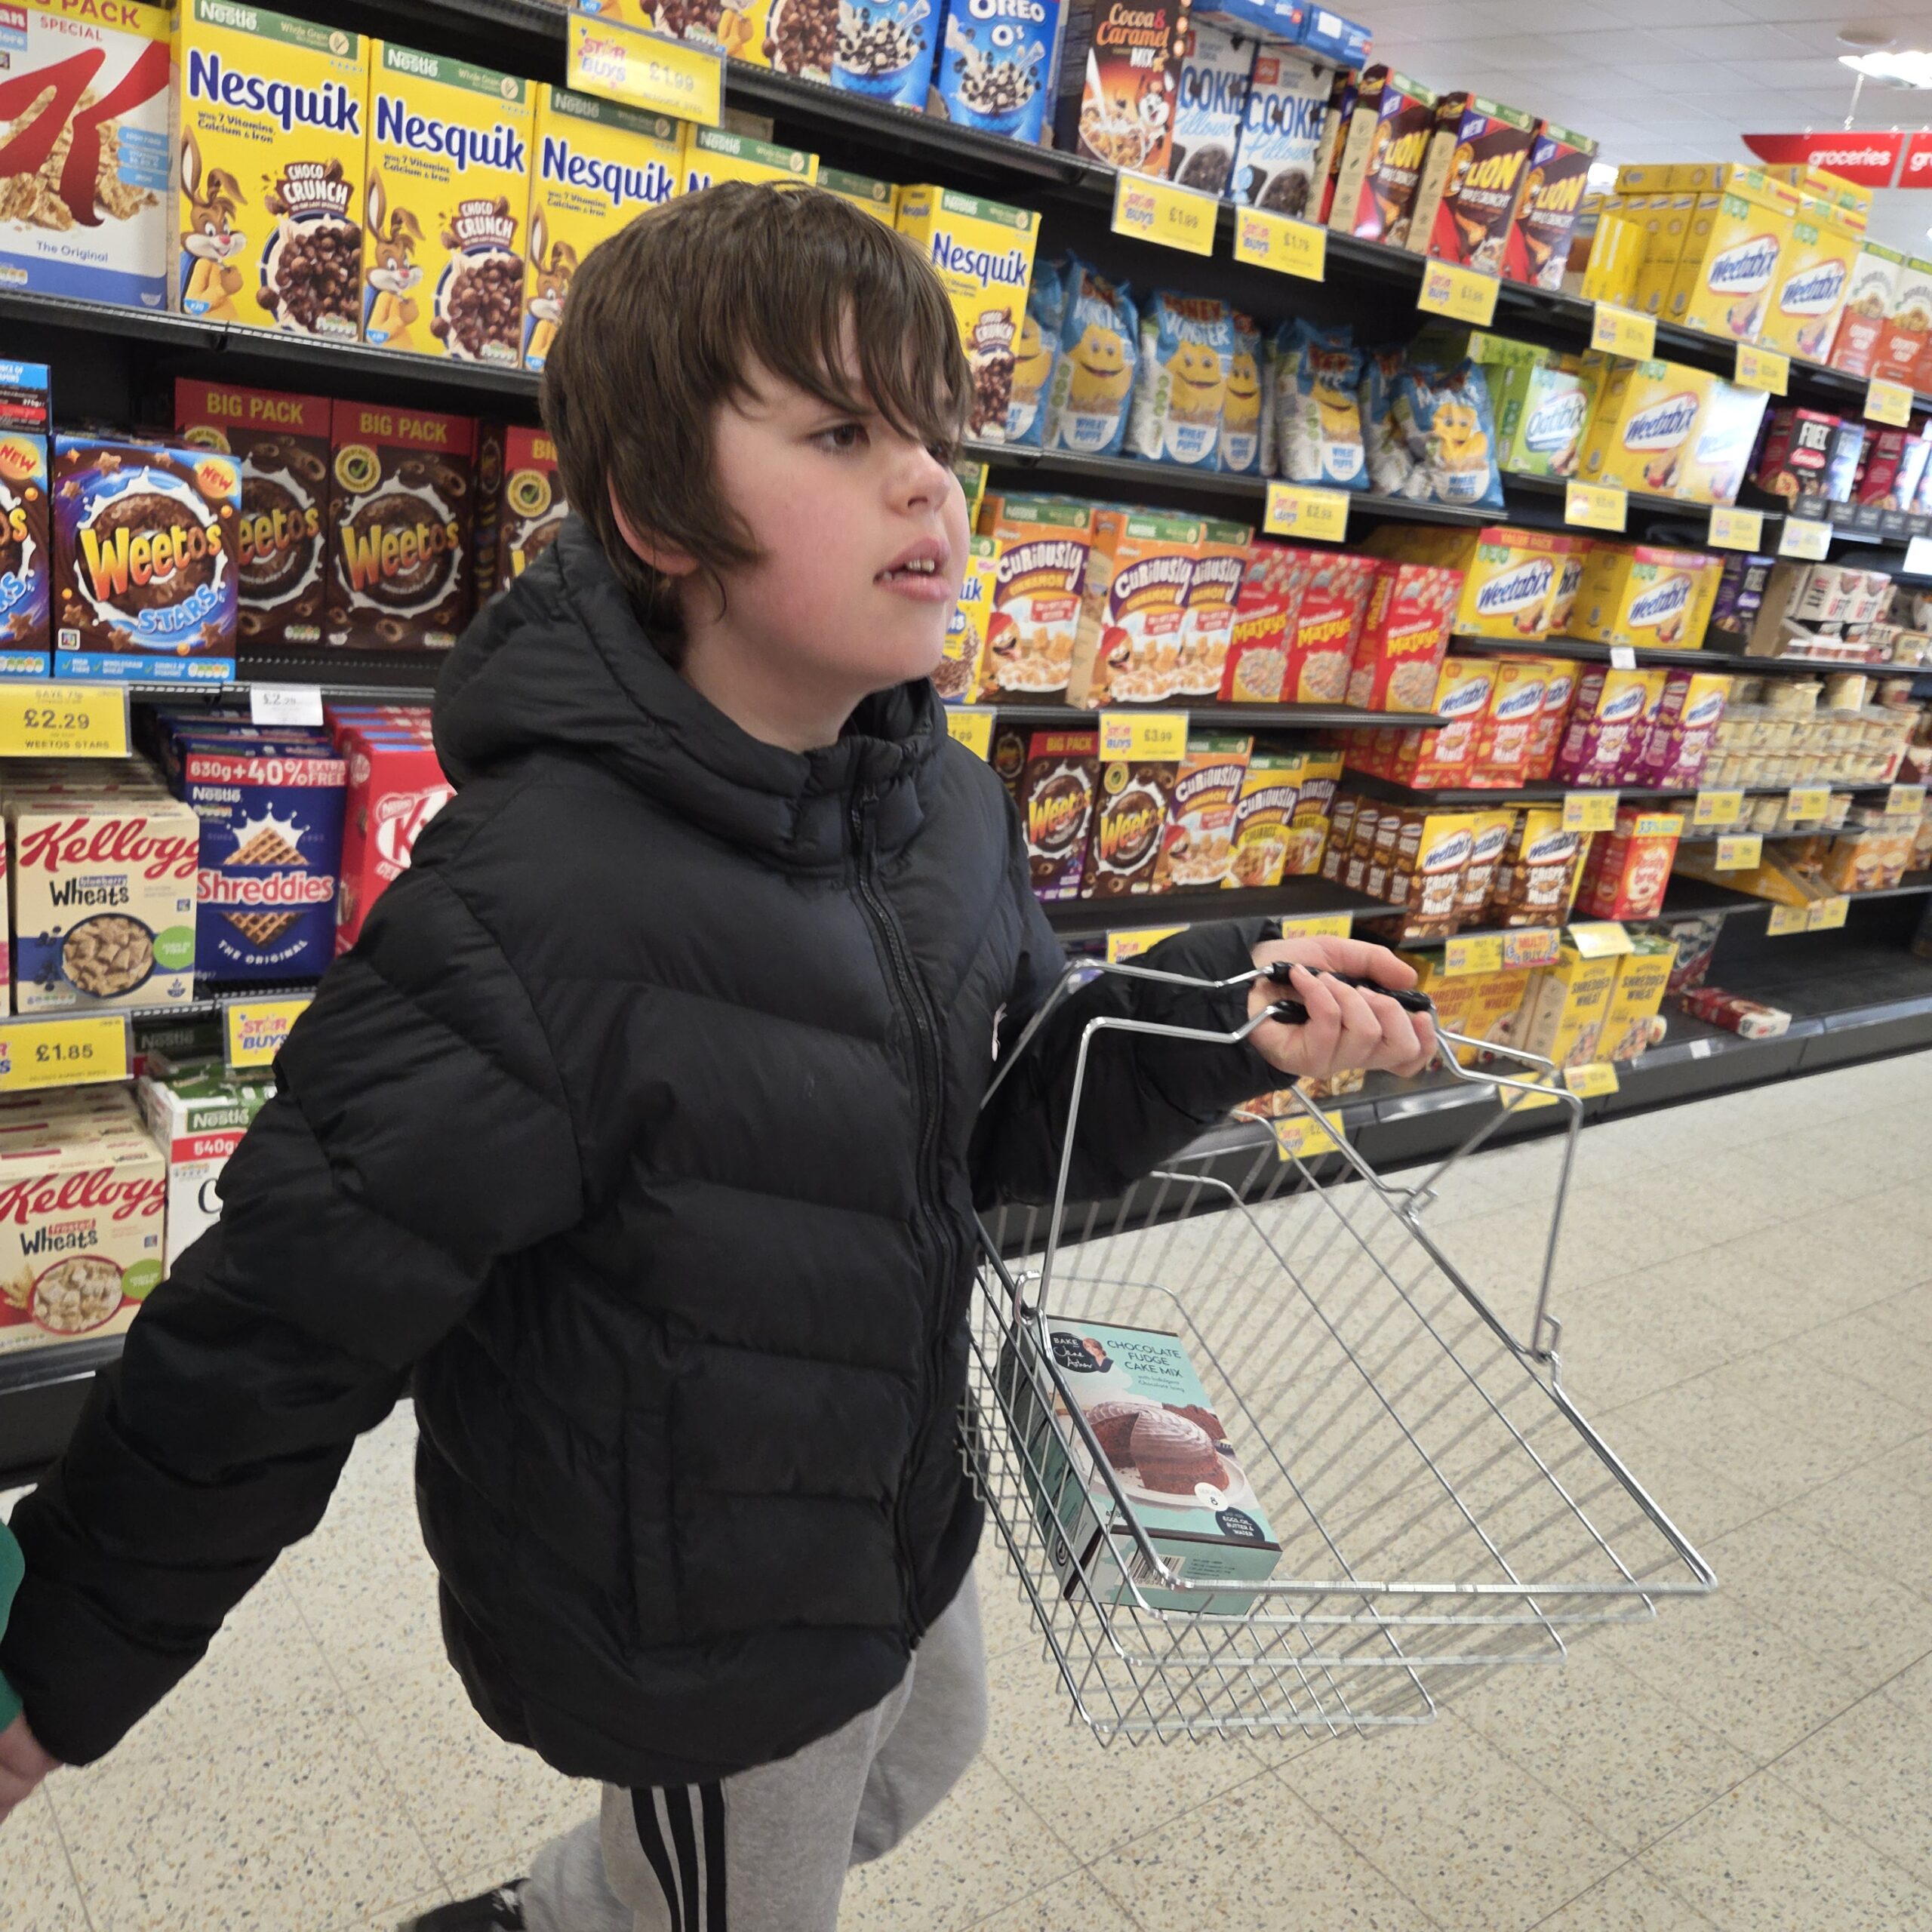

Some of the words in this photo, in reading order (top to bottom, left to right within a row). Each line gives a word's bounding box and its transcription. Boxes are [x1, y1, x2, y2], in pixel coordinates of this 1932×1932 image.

[200, 1, 258, 31] Nestlé
[969, 0, 1045, 22] OREO
[40, 15, 103, 42] SPECIAL
[1096, 21, 1171, 48] Caramel
[388, 49, 438, 78] Nestlé
[582, 57, 626, 82] BUYS
[1130, 47, 1156, 68] MIX
[190, 50, 359, 134] Nesquik
[198, 119, 242, 137] Calcium
[252, 132, 273, 144] Iron
[377, 96, 525, 172] Nesquik
[1384, 129, 1431, 171] LION
[1808, 146, 1891, 168] groceries
[288, 164, 324, 180] CHOCO
[383, 162, 422, 177] Calcium
[543, 137, 674, 205] Nesquik
[1465, 150, 1527, 190] LION
[283, 180, 349, 205] CRUNCH
[1535, 173, 1587, 212] LION
[460, 201, 492, 216] CHOCO
[455, 218, 512, 238] CRUNCH
[36, 241, 57, 254] The
[60, 244, 108, 263] Original
[931, 232, 1028, 287] Nesquik
[207, 392, 242, 417] BIG
[251, 397, 303, 424] PACK
[360, 413, 392, 435] BIG
[398, 418, 447, 443] PACK
[1626, 407, 1697, 442] Weetabix
[1, 445, 36, 472] NEW
[200, 466, 233, 491] NEW
[238, 508, 319, 565] eetos
[80, 525, 221, 601] Weetos
[342, 522, 459, 592] Weetos
[1478, 564, 1553, 608] Weetabix
[138, 583, 218, 634] STARS
[1629, 583, 1690, 620] Weetabix
[24, 709, 90, 729] £2.29
[25, 740, 70, 749] WEETOS
[75, 740, 109, 749] STARS
[1047, 737, 1063, 751] BIG
[1066, 737, 1092, 750] PACK
[1106, 739, 1131, 749] BUYS
[308, 761, 345, 773] EXTRA
[308, 771, 346, 786] FREE
[1029, 789, 1091, 844] Weetos
[1101, 806, 1165, 860] Weetos
[1426, 833, 1471, 866] Weetabix
[50, 878, 129, 907] Wheats
[197, 872, 334, 903] Shreddies
[218, 940, 241, 961] THE
[245, 940, 309, 964] ORIGINAL
[242, 1018, 287, 1033] STAR
[35, 1043, 94, 1061] £1.85
[141, 1032, 195, 1049] Nestlé
[193, 1109, 249, 1128] Nestlé
[20, 1227, 97, 1257] Wheats
[1107, 1340, 1182, 1358] CHOCOLATE
[1128, 1352, 1170, 1365] FUDGE
[1124, 1361, 1158, 1374] CAKE
[1160, 1367, 1183, 1378] MIX
[1210, 1497, 1218, 1506] 8
